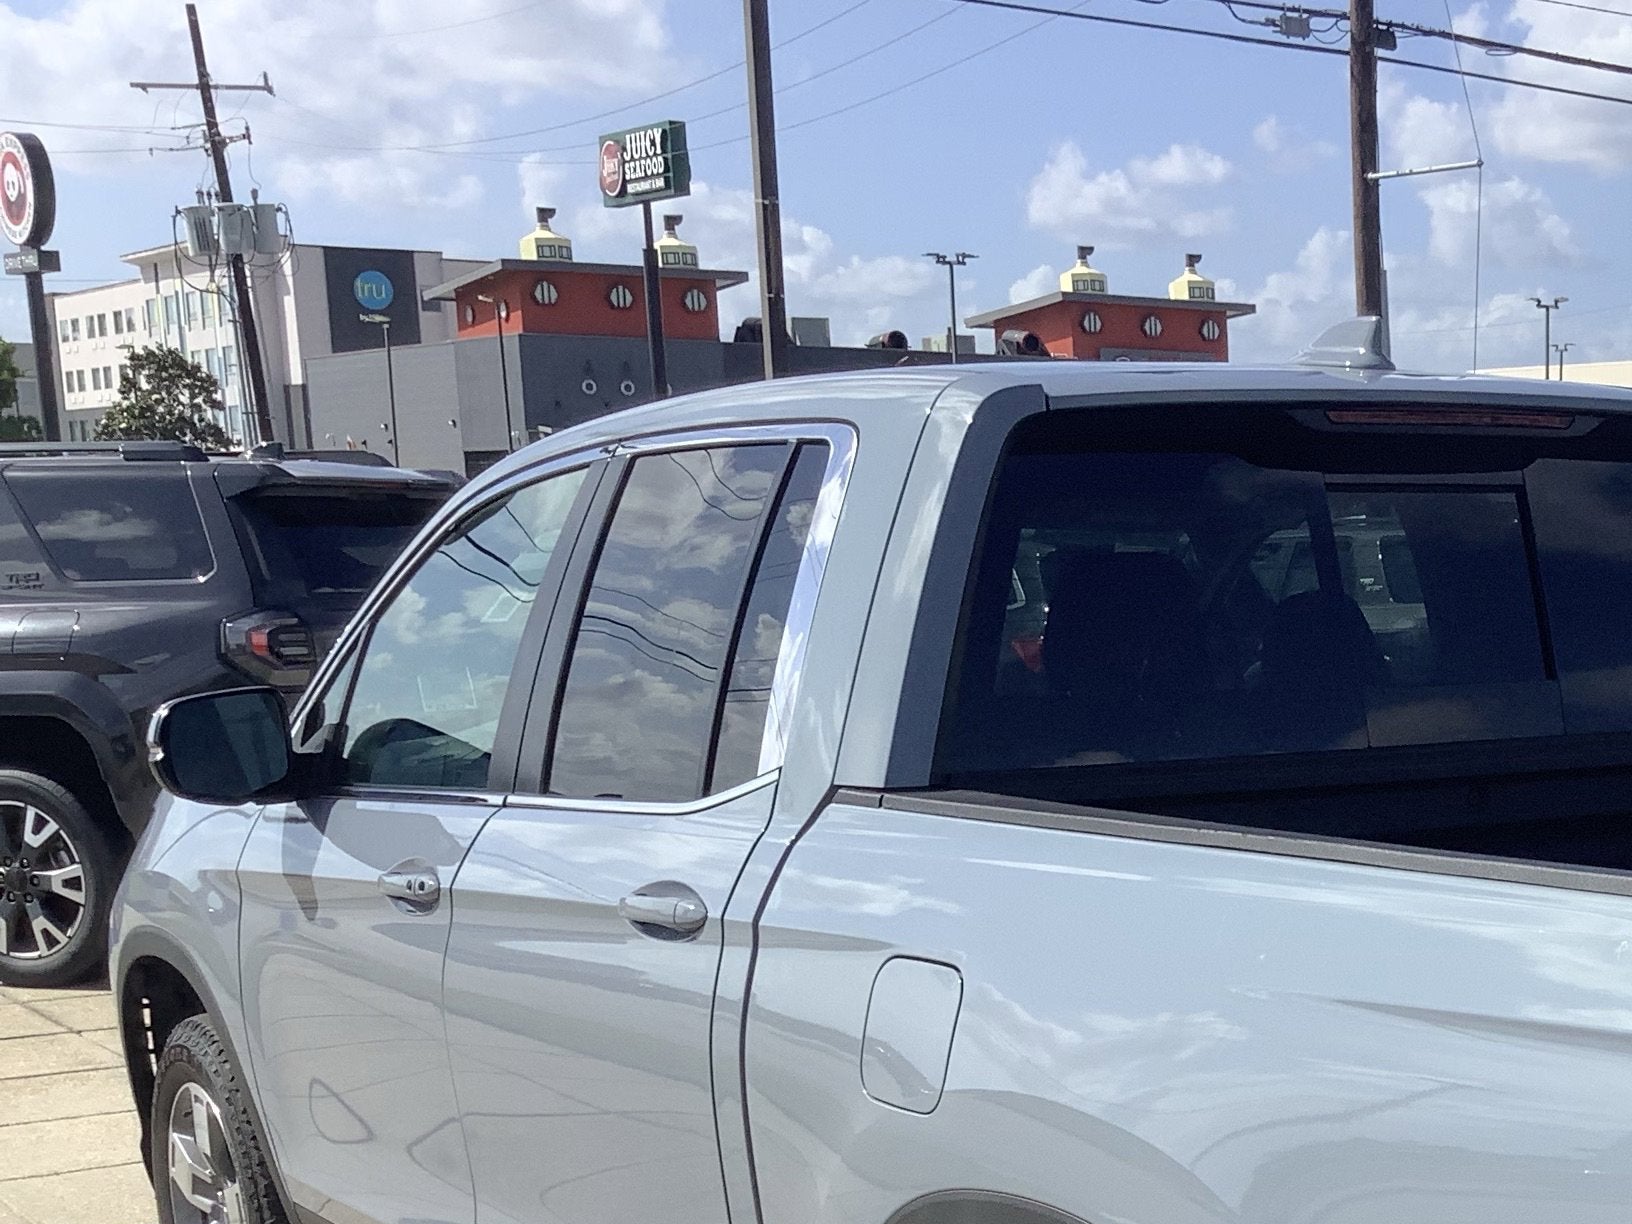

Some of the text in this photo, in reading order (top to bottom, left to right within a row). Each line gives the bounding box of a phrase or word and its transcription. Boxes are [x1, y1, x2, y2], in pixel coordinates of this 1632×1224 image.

[623, 128, 662, 161] JUICY
[624, 156, 664, 180] SEAFOOD
[358, 279, 386, 299] tru
